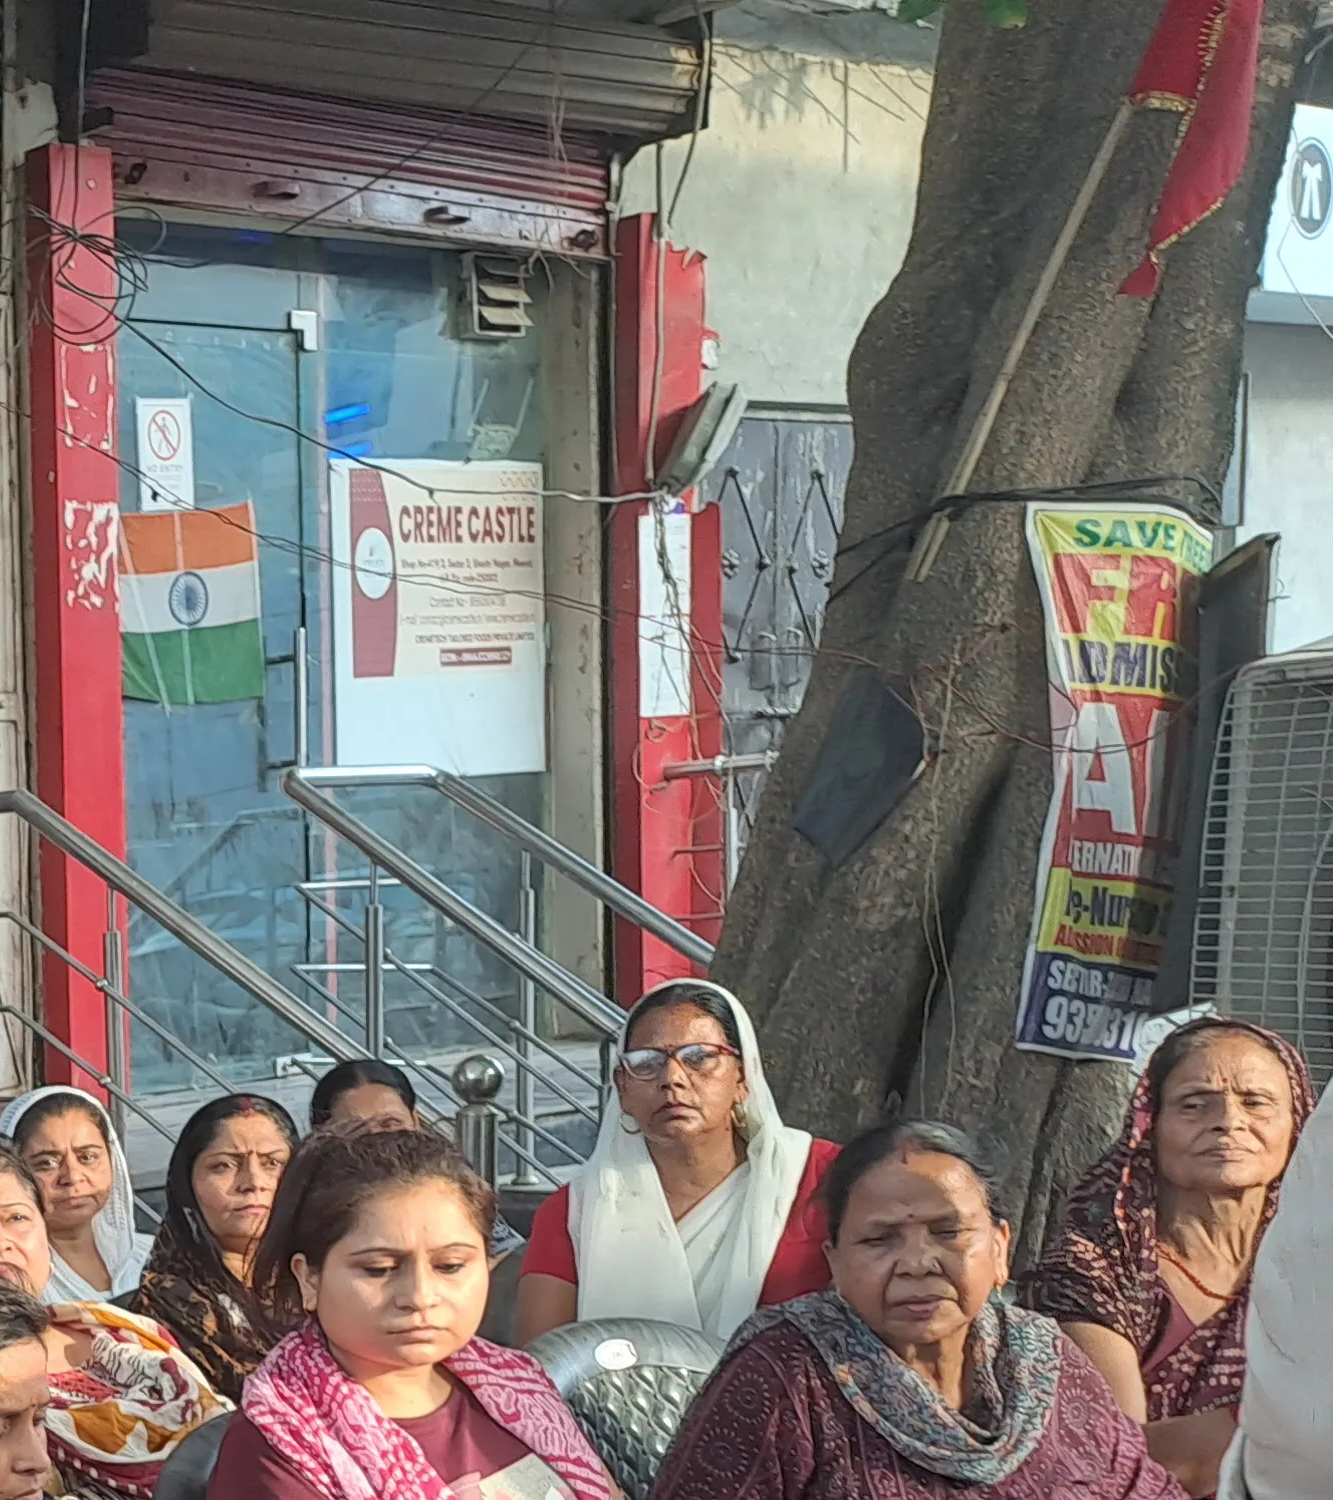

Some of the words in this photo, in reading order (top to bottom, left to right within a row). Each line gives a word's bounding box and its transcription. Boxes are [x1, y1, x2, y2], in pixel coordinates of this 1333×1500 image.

[399, 505, 463, 544] CREME
[468, 505, 536, 544] CASTLE
[1074, 519, 1177, 550] SAVE
